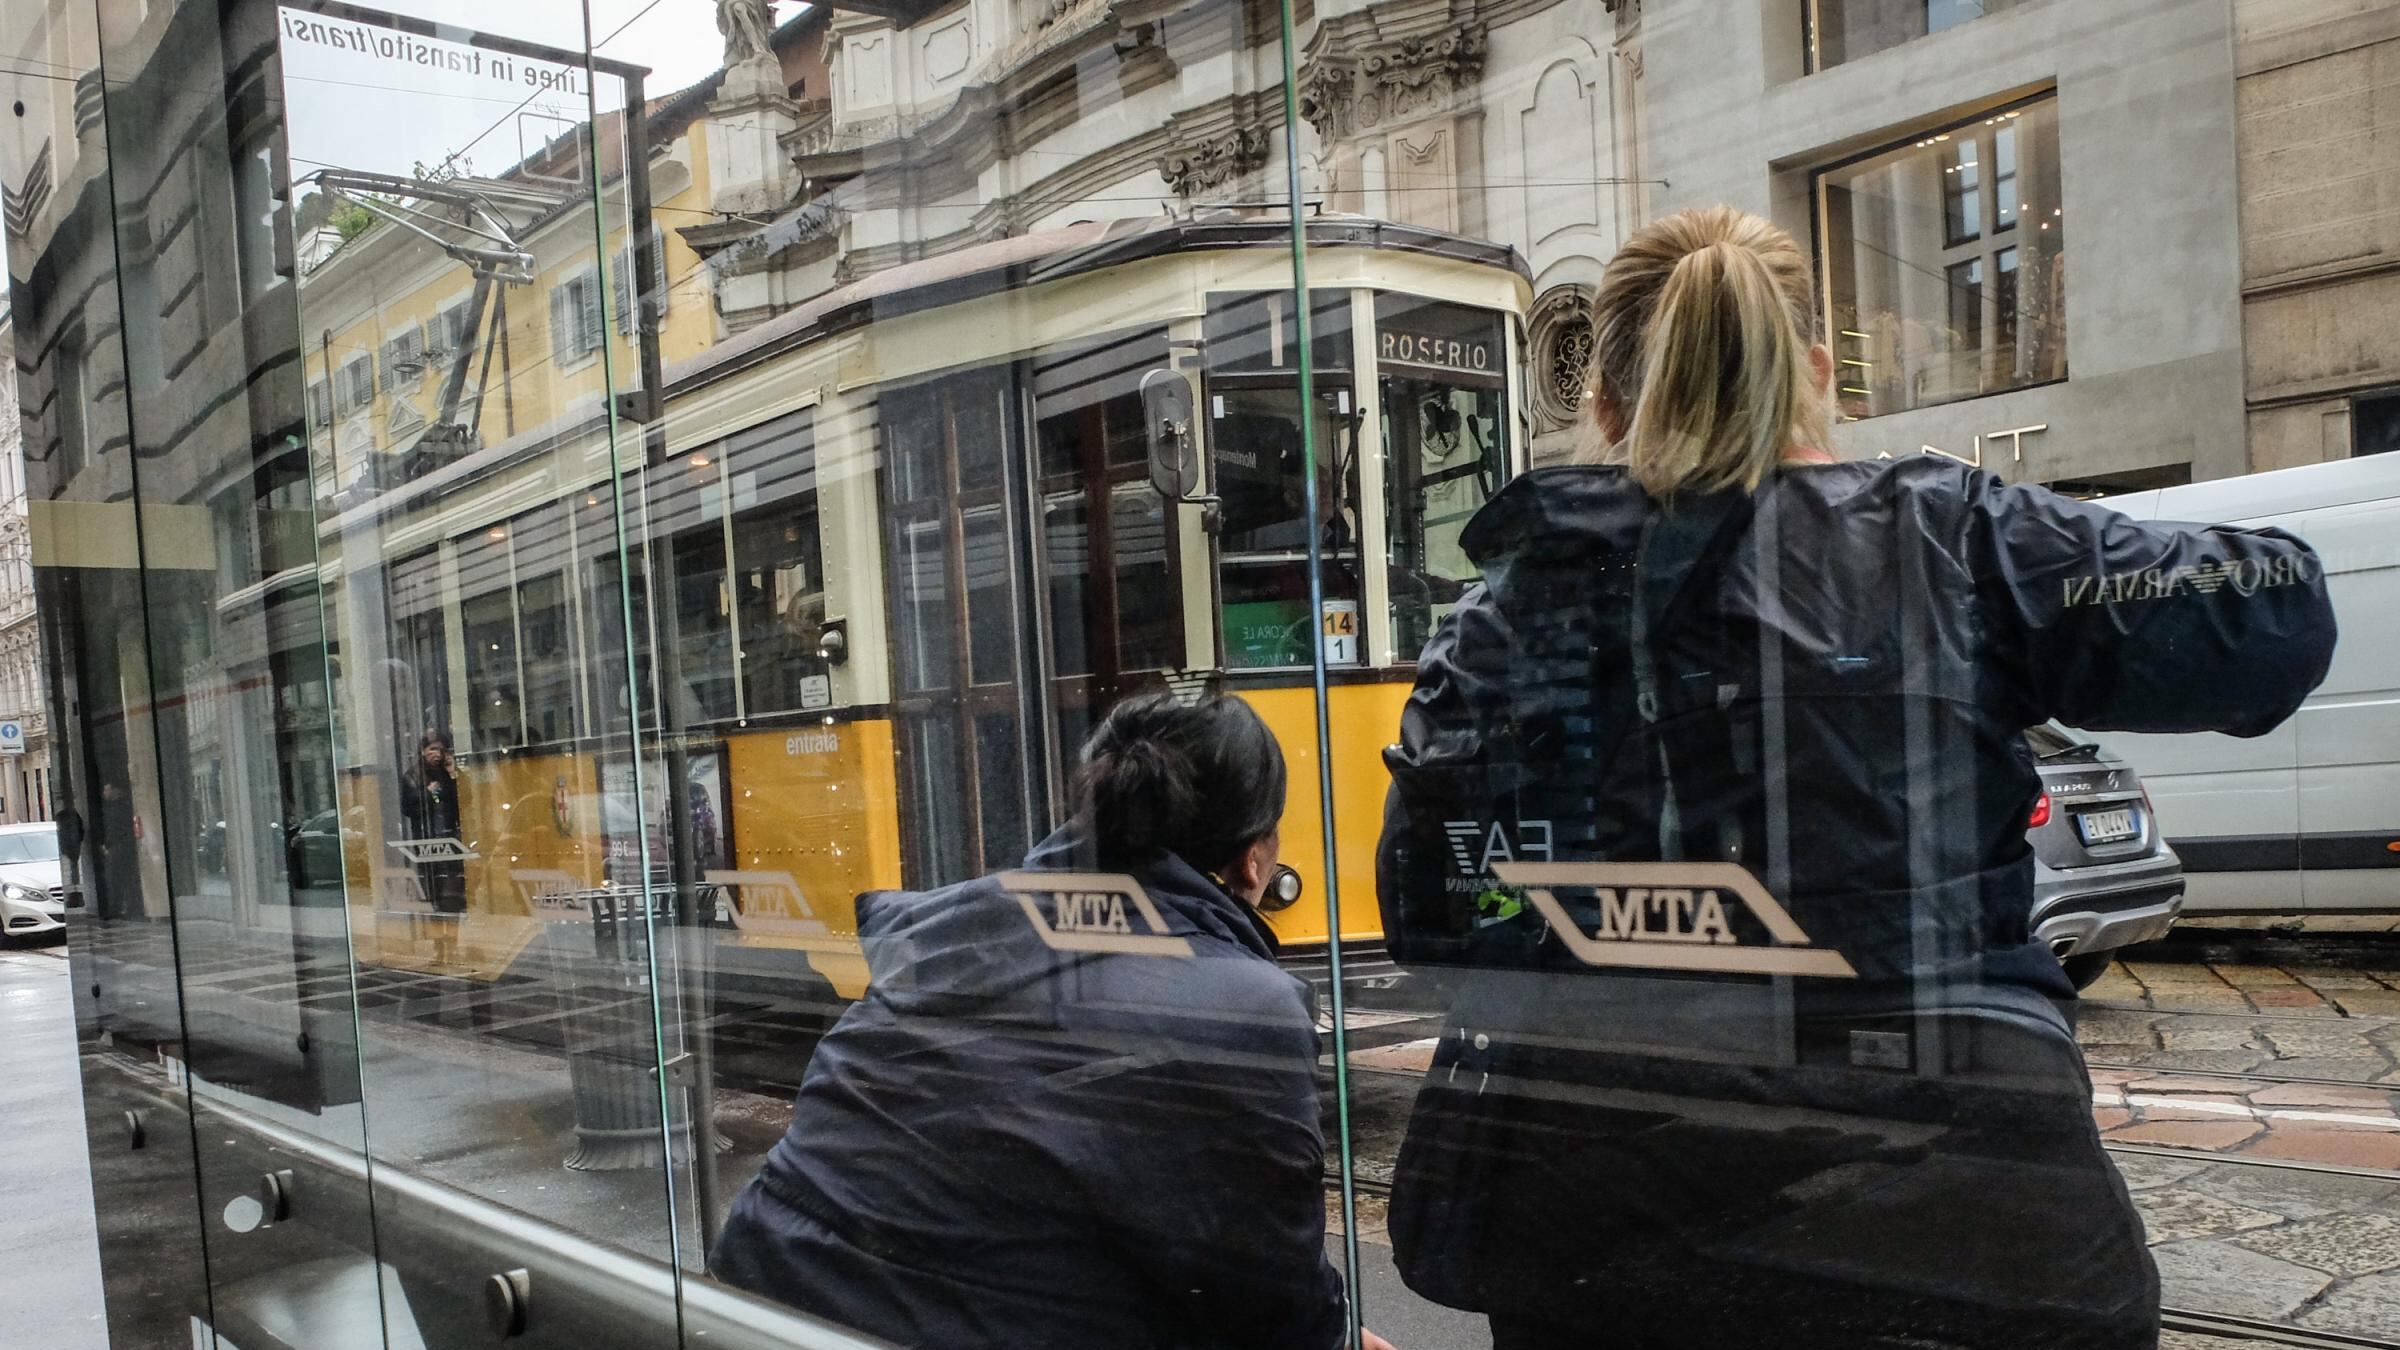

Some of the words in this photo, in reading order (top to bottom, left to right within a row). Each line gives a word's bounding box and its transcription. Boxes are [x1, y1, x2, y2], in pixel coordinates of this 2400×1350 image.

[1266, 292, 1284, 367] 1
[1381, 331, 1487, 370] ROSERIO
[1877, 423, 2048, 468] NT
[1325, 612, 1352, 635] 14
[1333, 638, 1345, 660] 1
[785, 732, 839, 756] entrata
